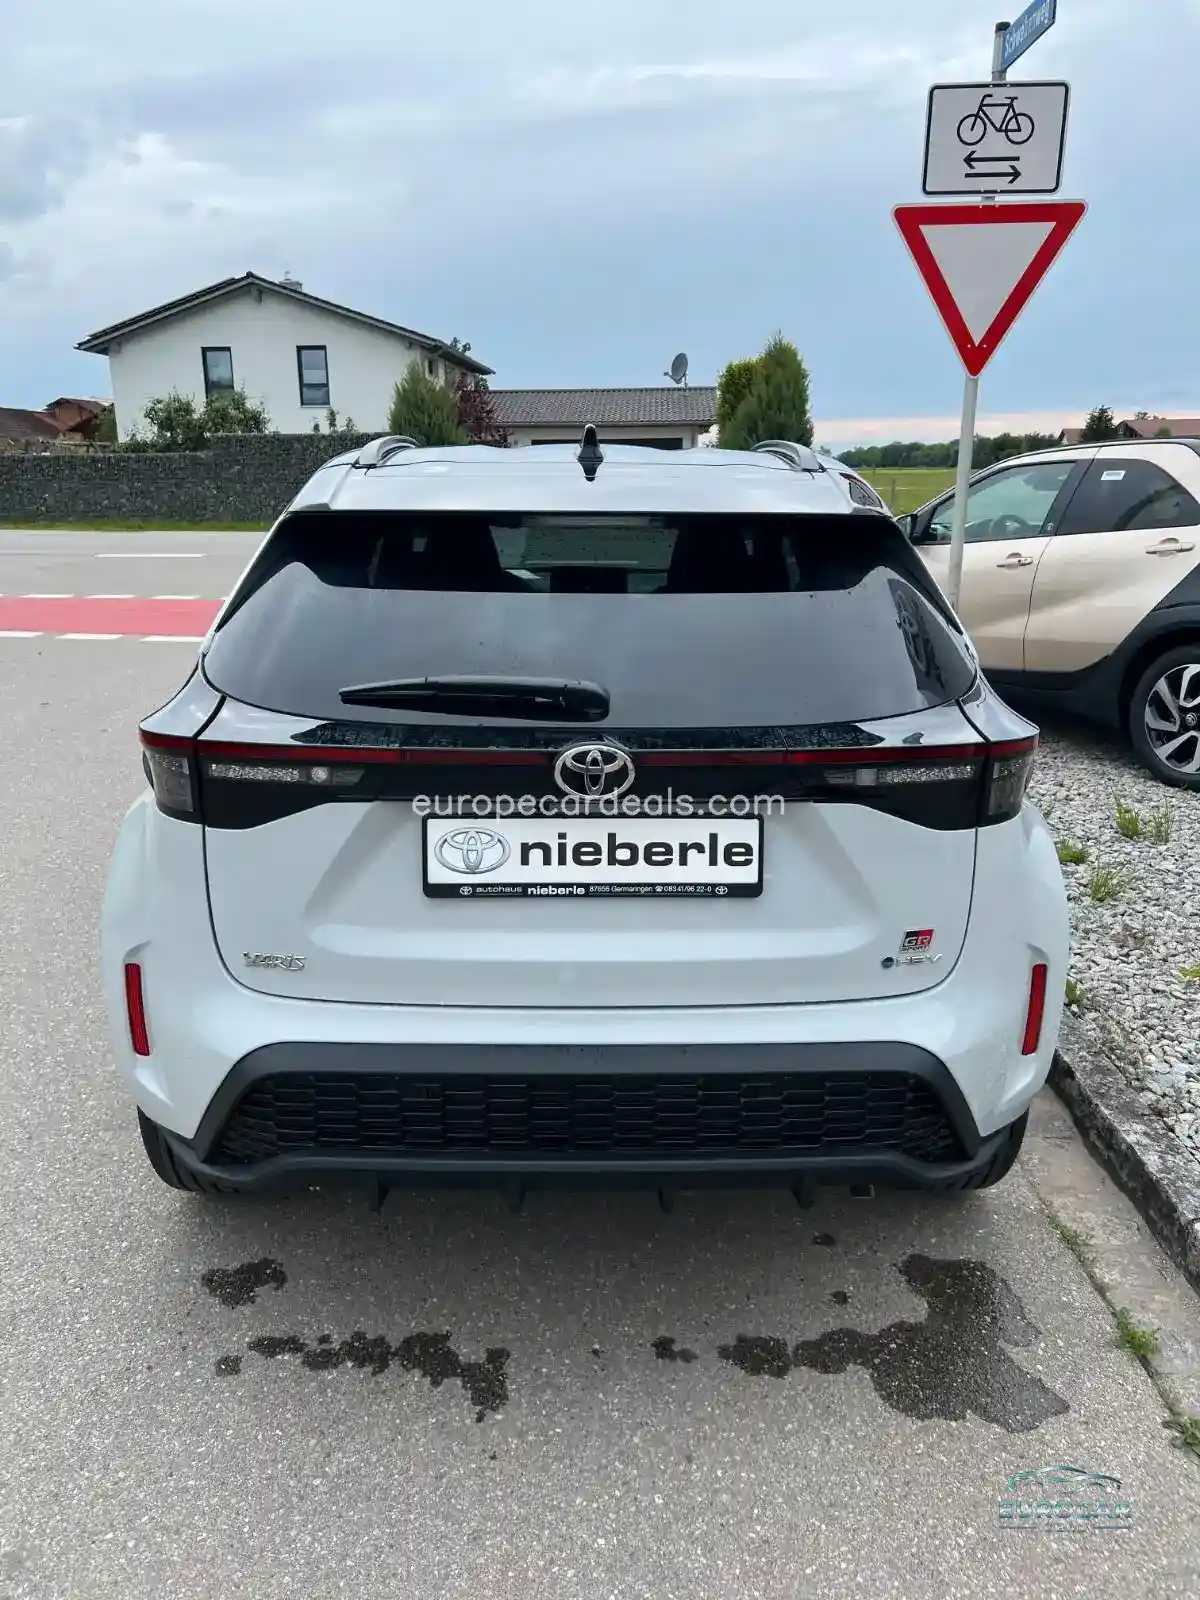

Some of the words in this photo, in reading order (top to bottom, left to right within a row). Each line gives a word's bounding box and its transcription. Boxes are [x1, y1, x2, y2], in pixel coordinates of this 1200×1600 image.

[520, 832, 754, 867] nieberle
[475, 885, 523, 894] autohaus
[527, 885, 586, 895] nieberle
[903, 936, 931, 946] GR
